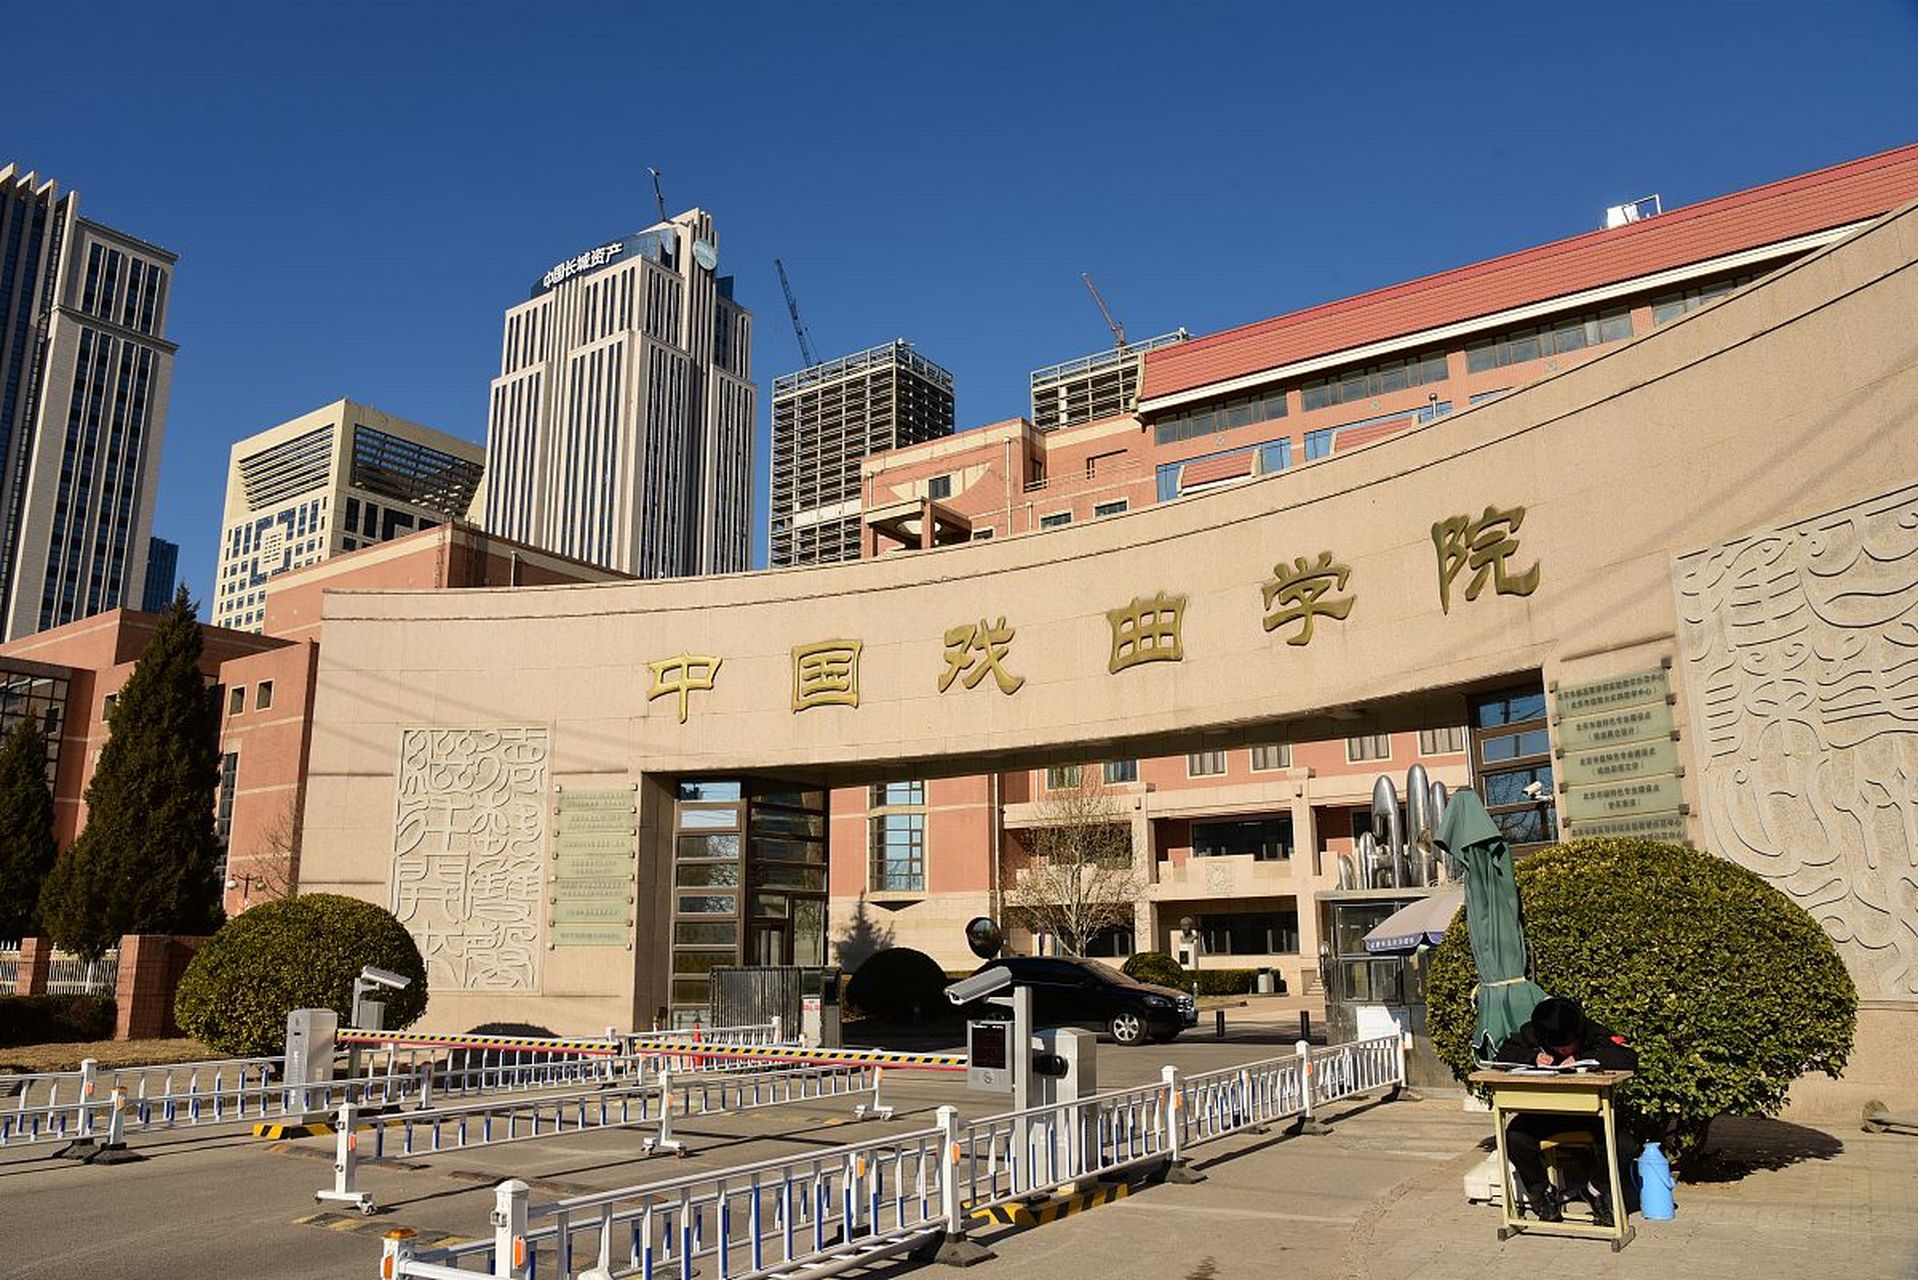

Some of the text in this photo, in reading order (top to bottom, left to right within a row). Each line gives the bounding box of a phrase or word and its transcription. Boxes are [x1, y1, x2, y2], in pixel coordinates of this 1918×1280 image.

[543, 242, 623, 288] 中国长城资产
[646, 505, 1541, 725] 中国戏曲学院
